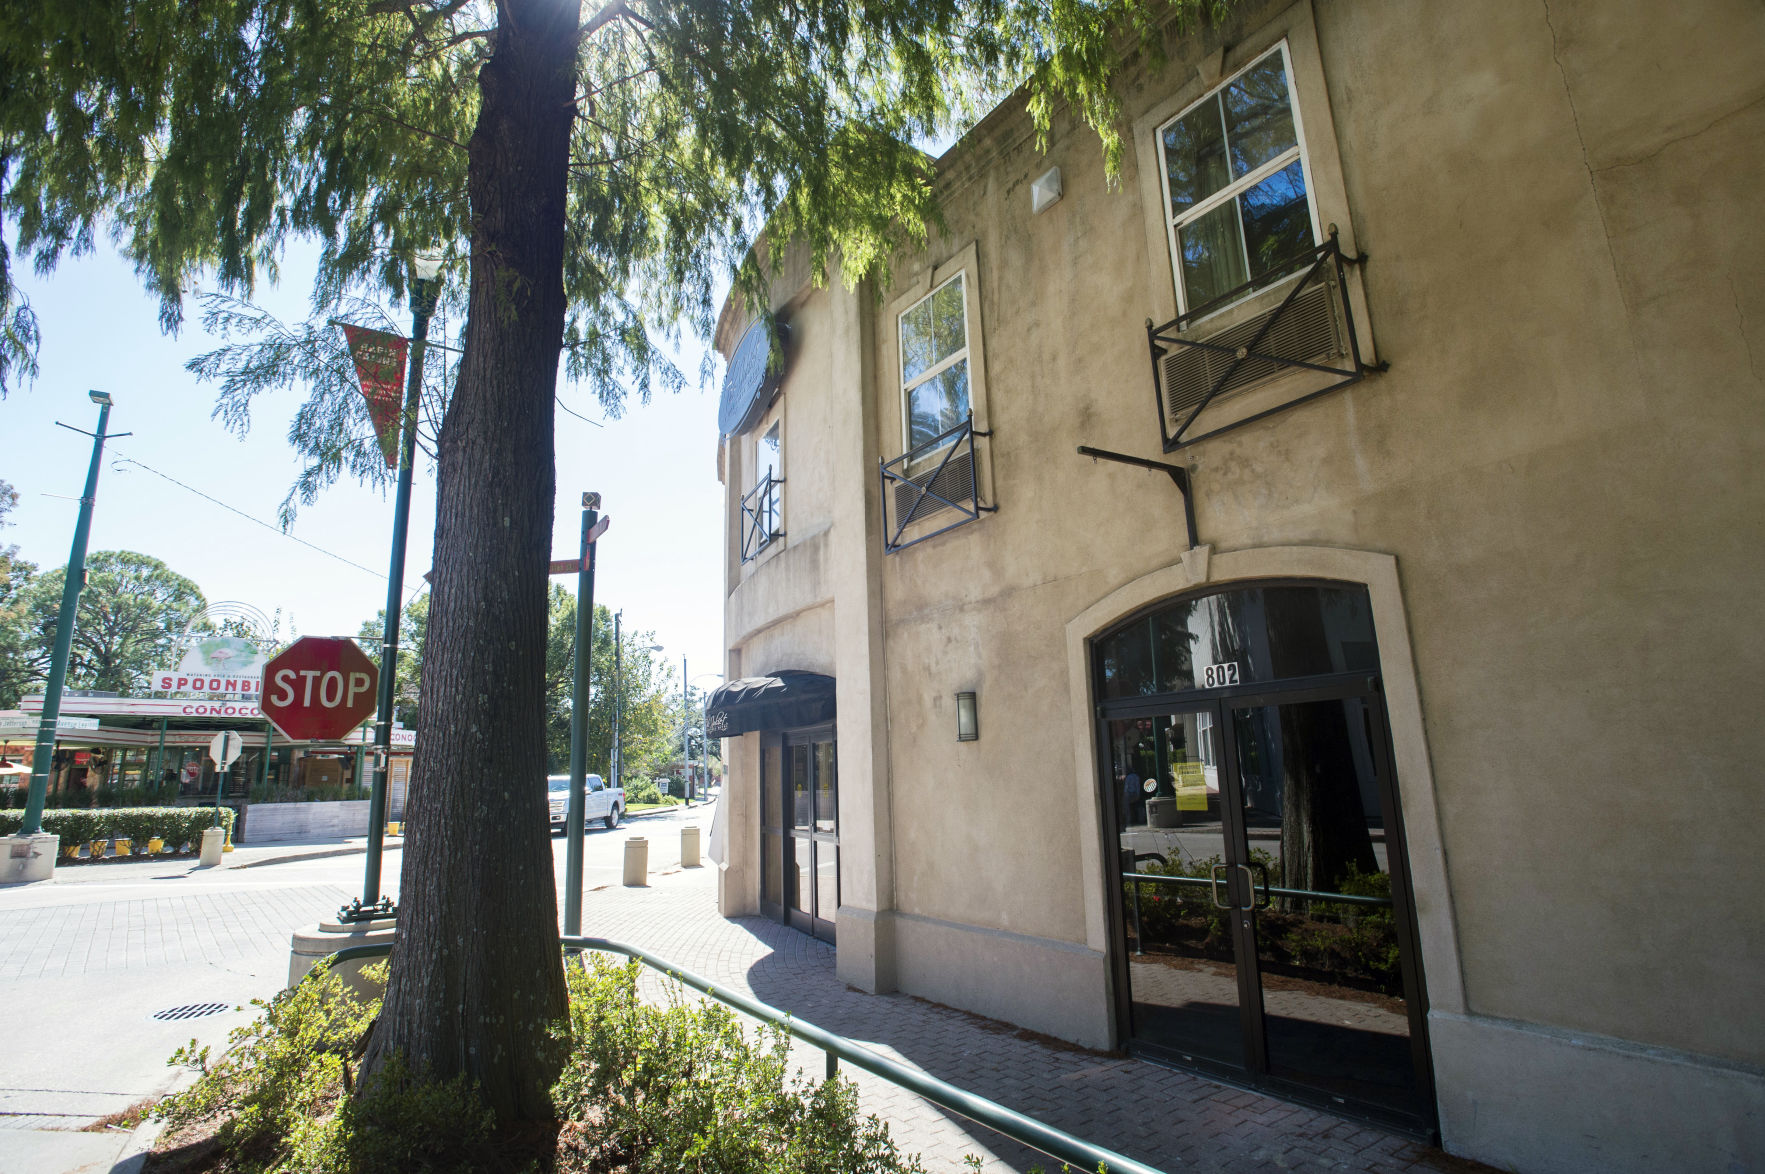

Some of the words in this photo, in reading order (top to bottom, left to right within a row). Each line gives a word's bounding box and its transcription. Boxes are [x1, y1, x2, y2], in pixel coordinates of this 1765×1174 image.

[1205, 663, 1238, 687] 802
[270, 668, 371, 708] STOP
[182, 704, 261, 717] CONOCO
[391, 733, 416, 742] CONO
